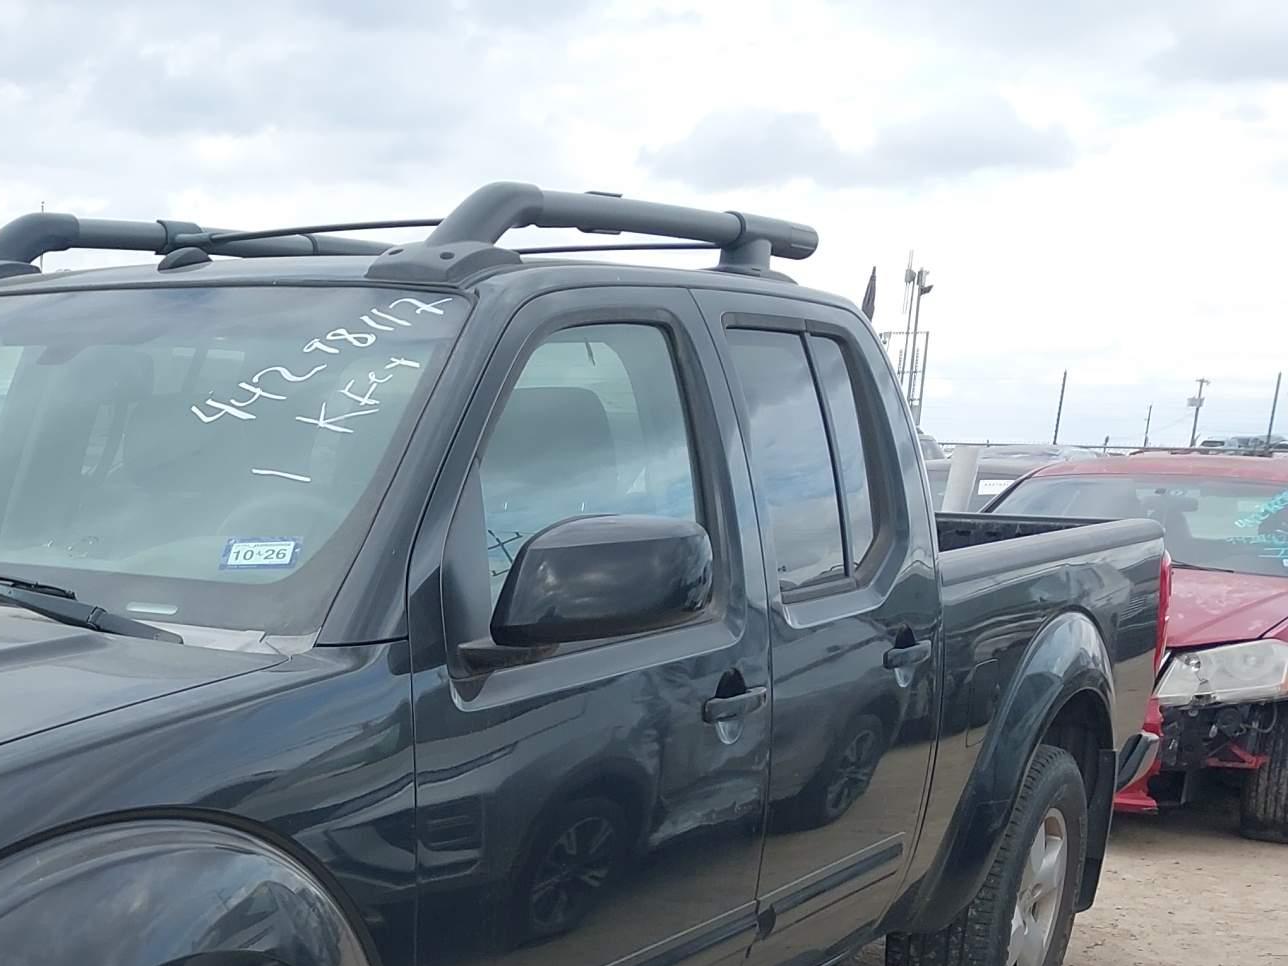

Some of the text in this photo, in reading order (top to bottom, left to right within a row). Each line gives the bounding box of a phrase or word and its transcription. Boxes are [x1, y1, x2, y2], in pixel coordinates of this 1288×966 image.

[190, 297, 454, 424] 44298117
[233, 547, 289, 562] 10 26
